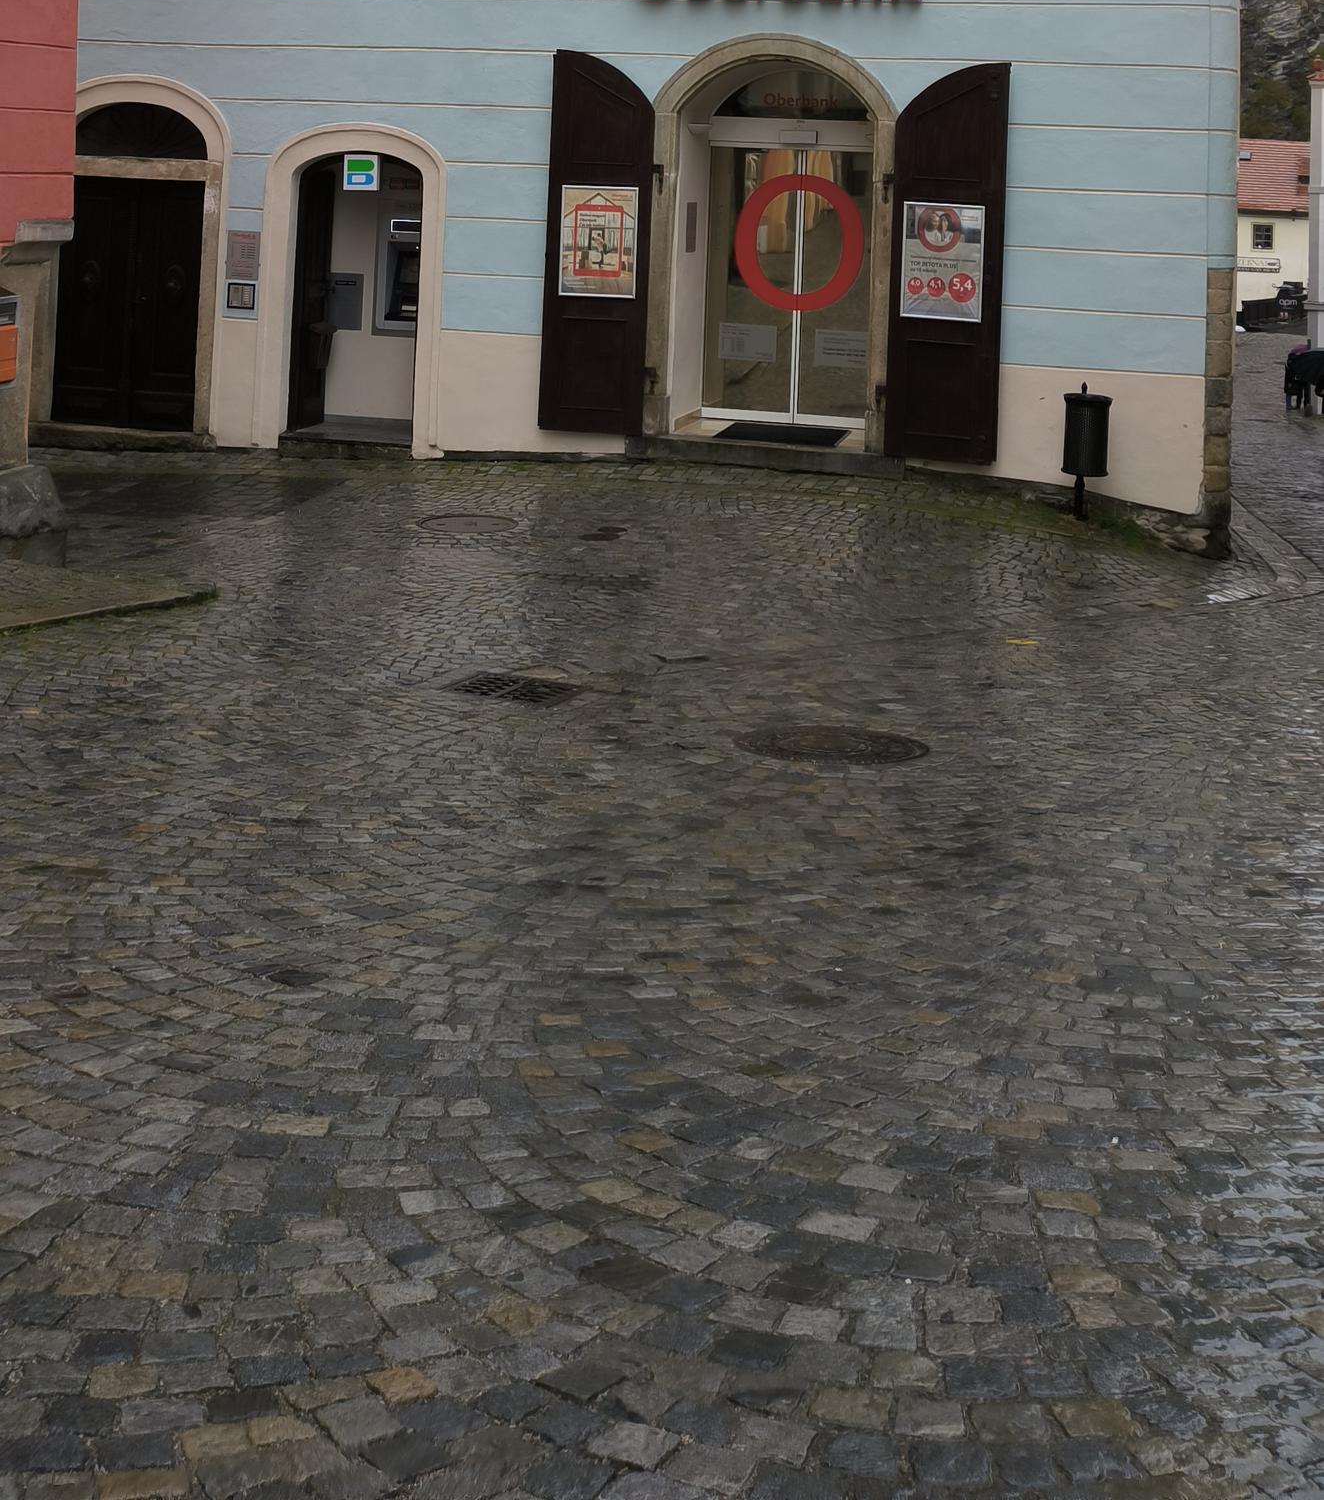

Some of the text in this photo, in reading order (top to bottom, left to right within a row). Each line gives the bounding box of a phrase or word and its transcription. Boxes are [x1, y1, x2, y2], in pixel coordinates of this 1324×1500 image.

[763, 92, 839, 109] Oberbank
[929, 280, 942, 289] 4,1
[952, 278, 973, 291] 5,4
